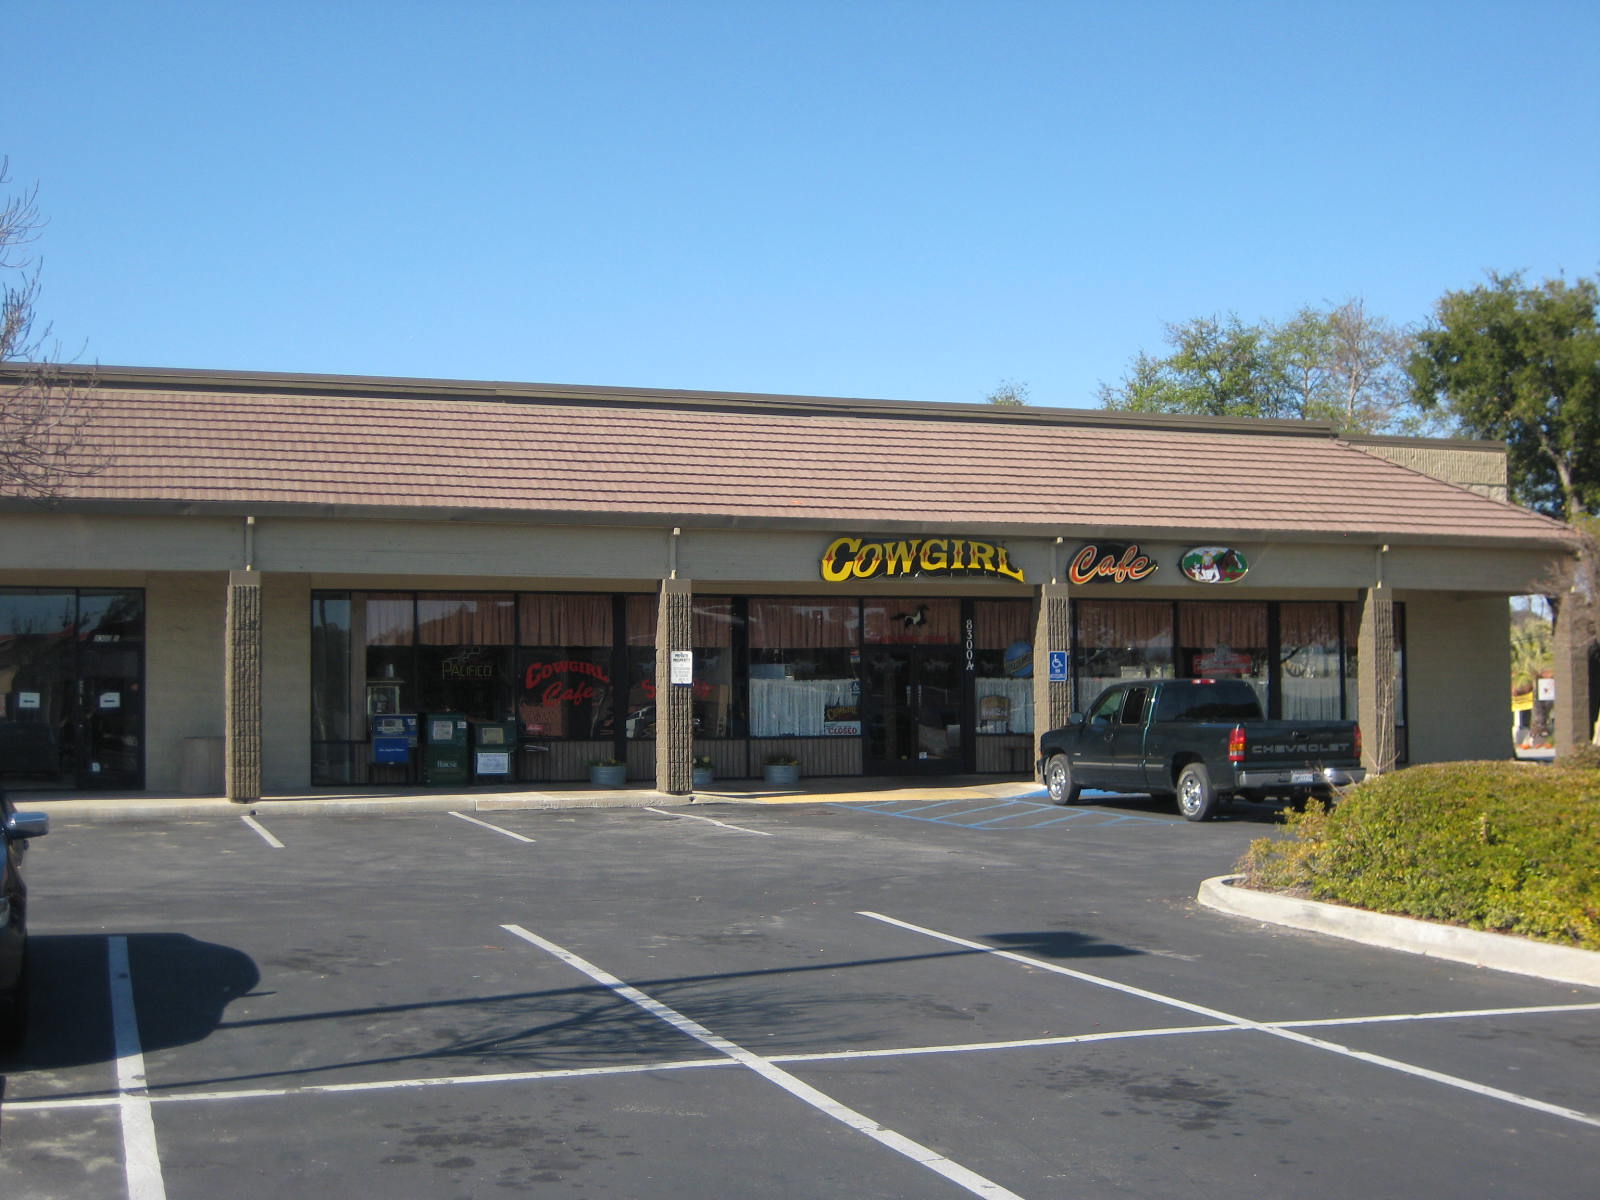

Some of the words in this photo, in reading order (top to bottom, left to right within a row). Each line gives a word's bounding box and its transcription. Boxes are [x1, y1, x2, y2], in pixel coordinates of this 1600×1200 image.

[820, 537, 1025, 582] COWGIRL
[1069, 545, 1157, 584] Cafe
[525, 661, 609, 689] COWGIRL
[543, 681, 594, 706] Cafe
[1252, 744, 1350, 753] CHEVROLET
